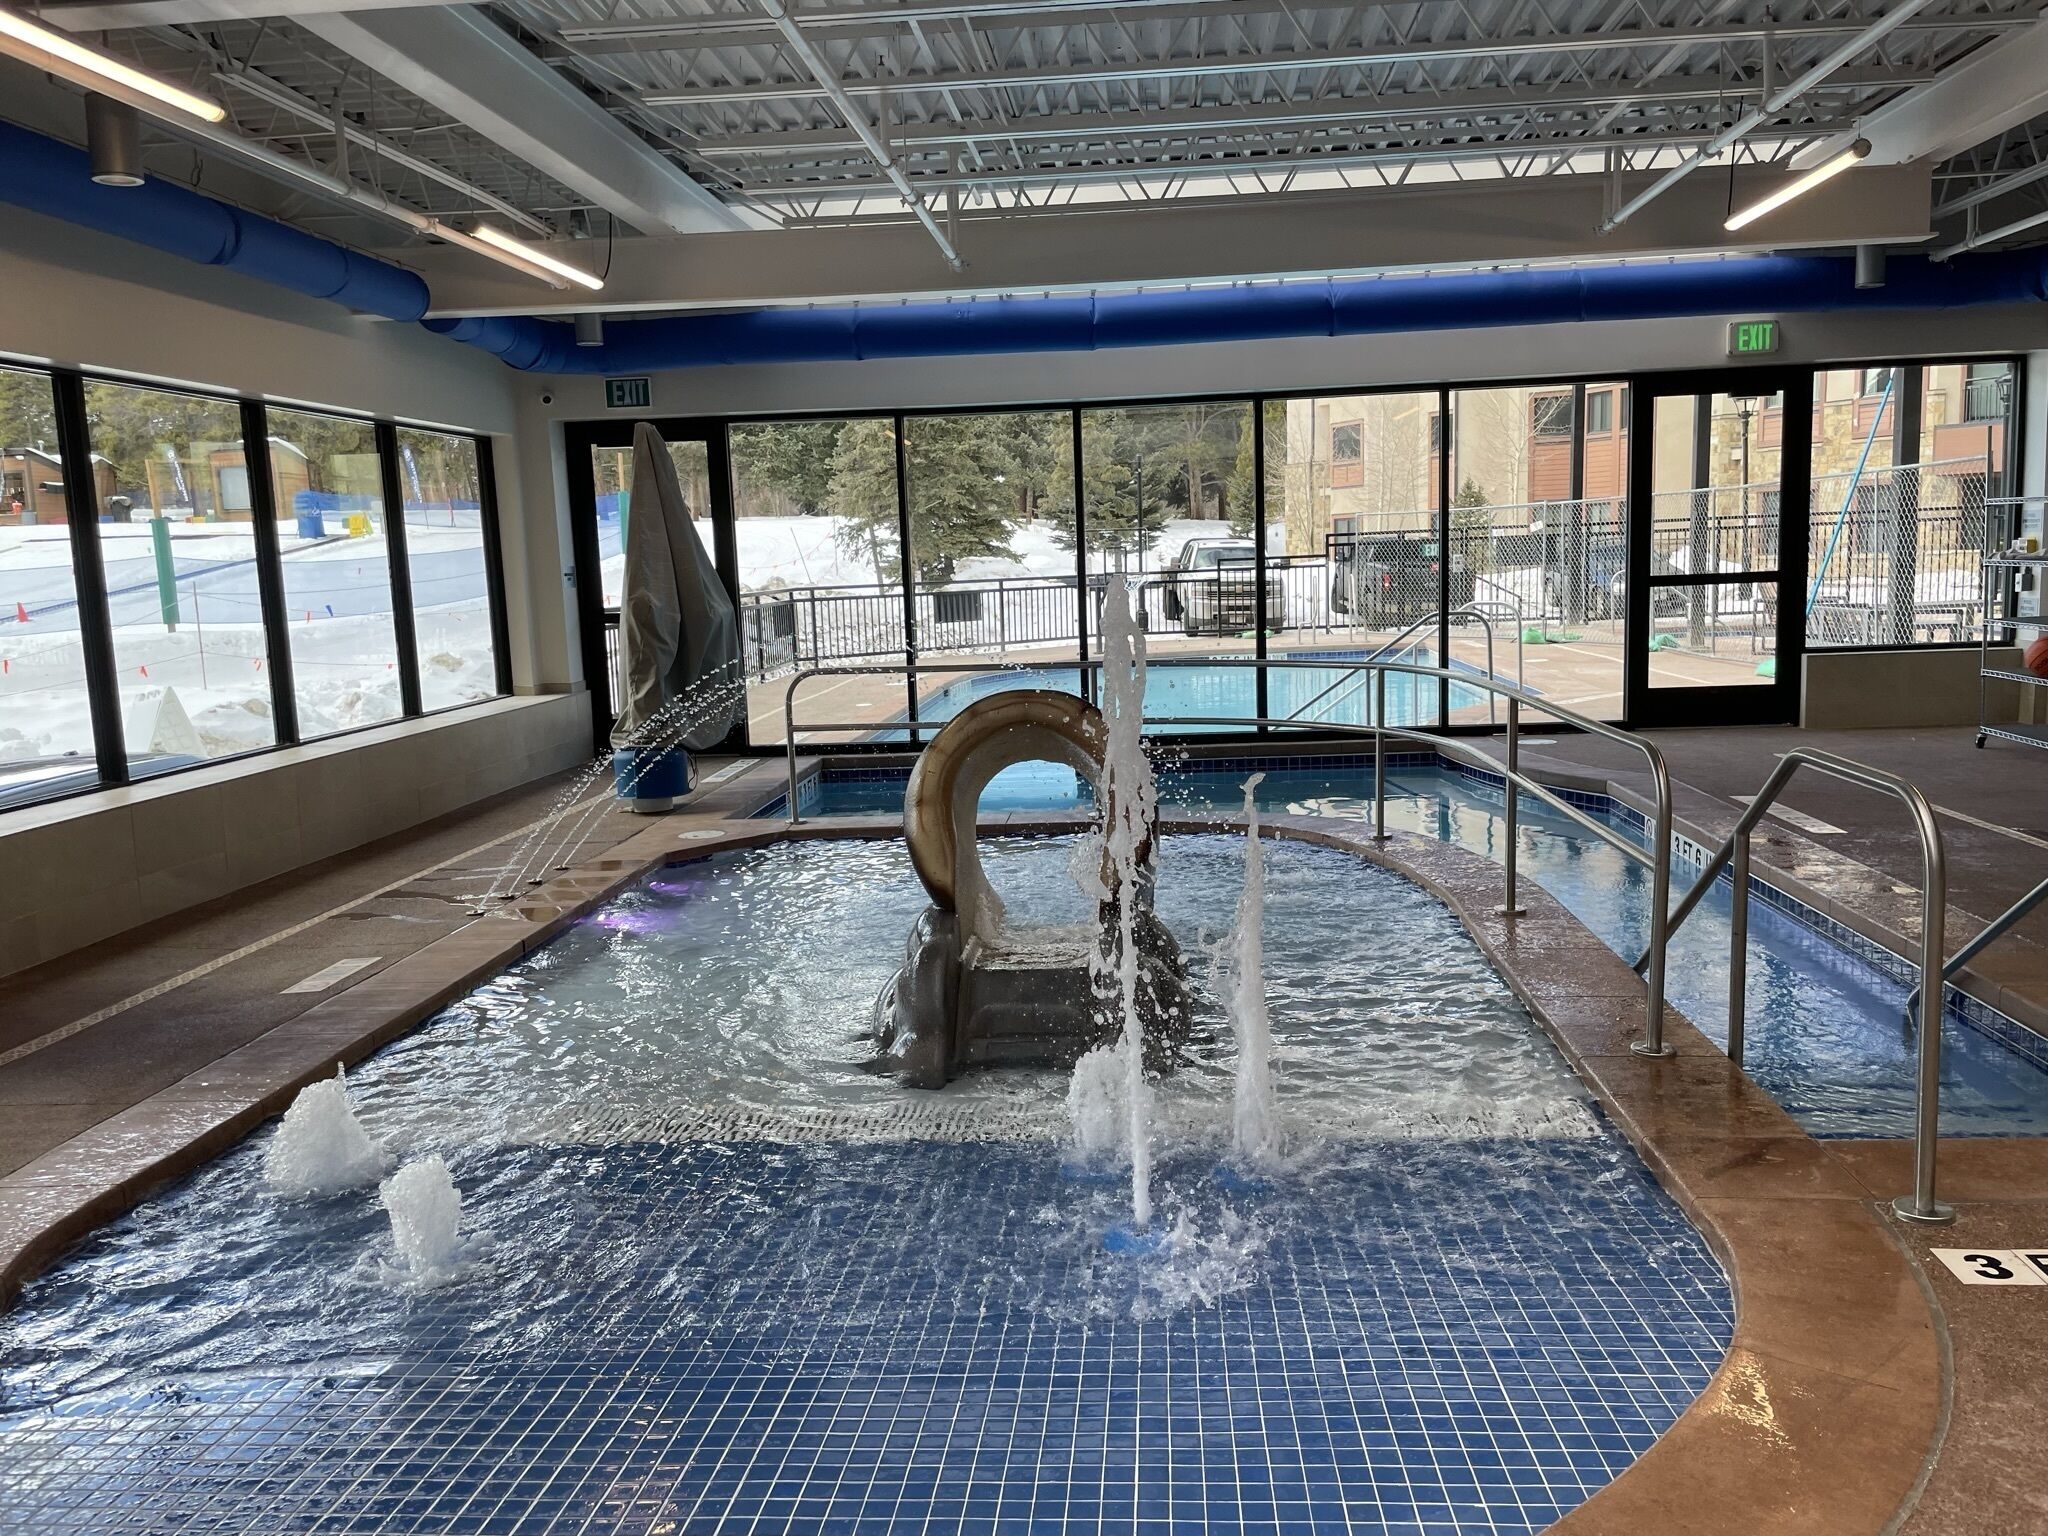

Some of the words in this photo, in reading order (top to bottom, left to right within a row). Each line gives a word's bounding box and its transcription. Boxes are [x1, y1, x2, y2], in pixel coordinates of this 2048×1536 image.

[1738, 324, 1772, 351] EXIT
[612, 380, 645, 405] EXIT
[1674, 836, 1680, 853] 3
[1683, 841, 1692, 860] FT
[1695, 848, 1701, 866] 6
[1963, 1254, 2014, 1280] 3
